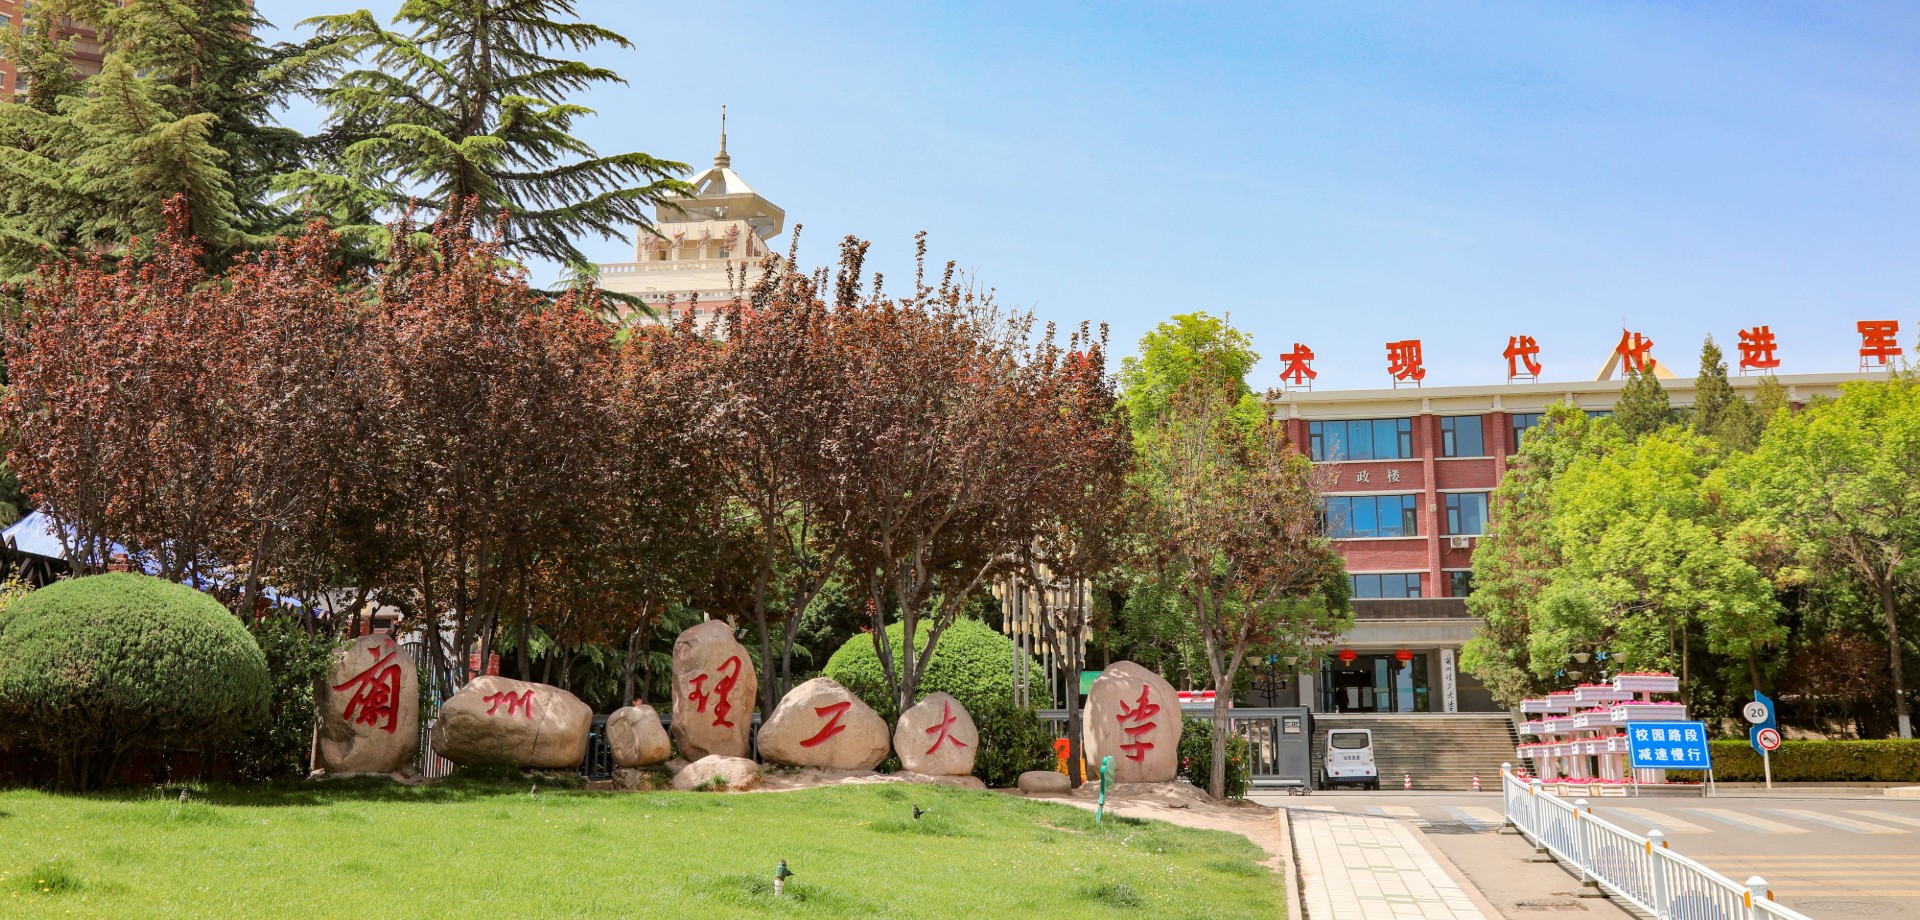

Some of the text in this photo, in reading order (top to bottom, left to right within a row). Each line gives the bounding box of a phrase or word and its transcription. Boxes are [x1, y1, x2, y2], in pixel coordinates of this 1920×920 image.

[482, 689, 536, 719] 州
[688, 655, 743, 729] 理
[799, 701, 852, 748] 工
[925, 701, 967, 755] 大
[1750, 708, 1764, 718] 20
[1635, 728, 1699, 742] 校园路段
[1638, 747, 1701, 761] 减速慢行
